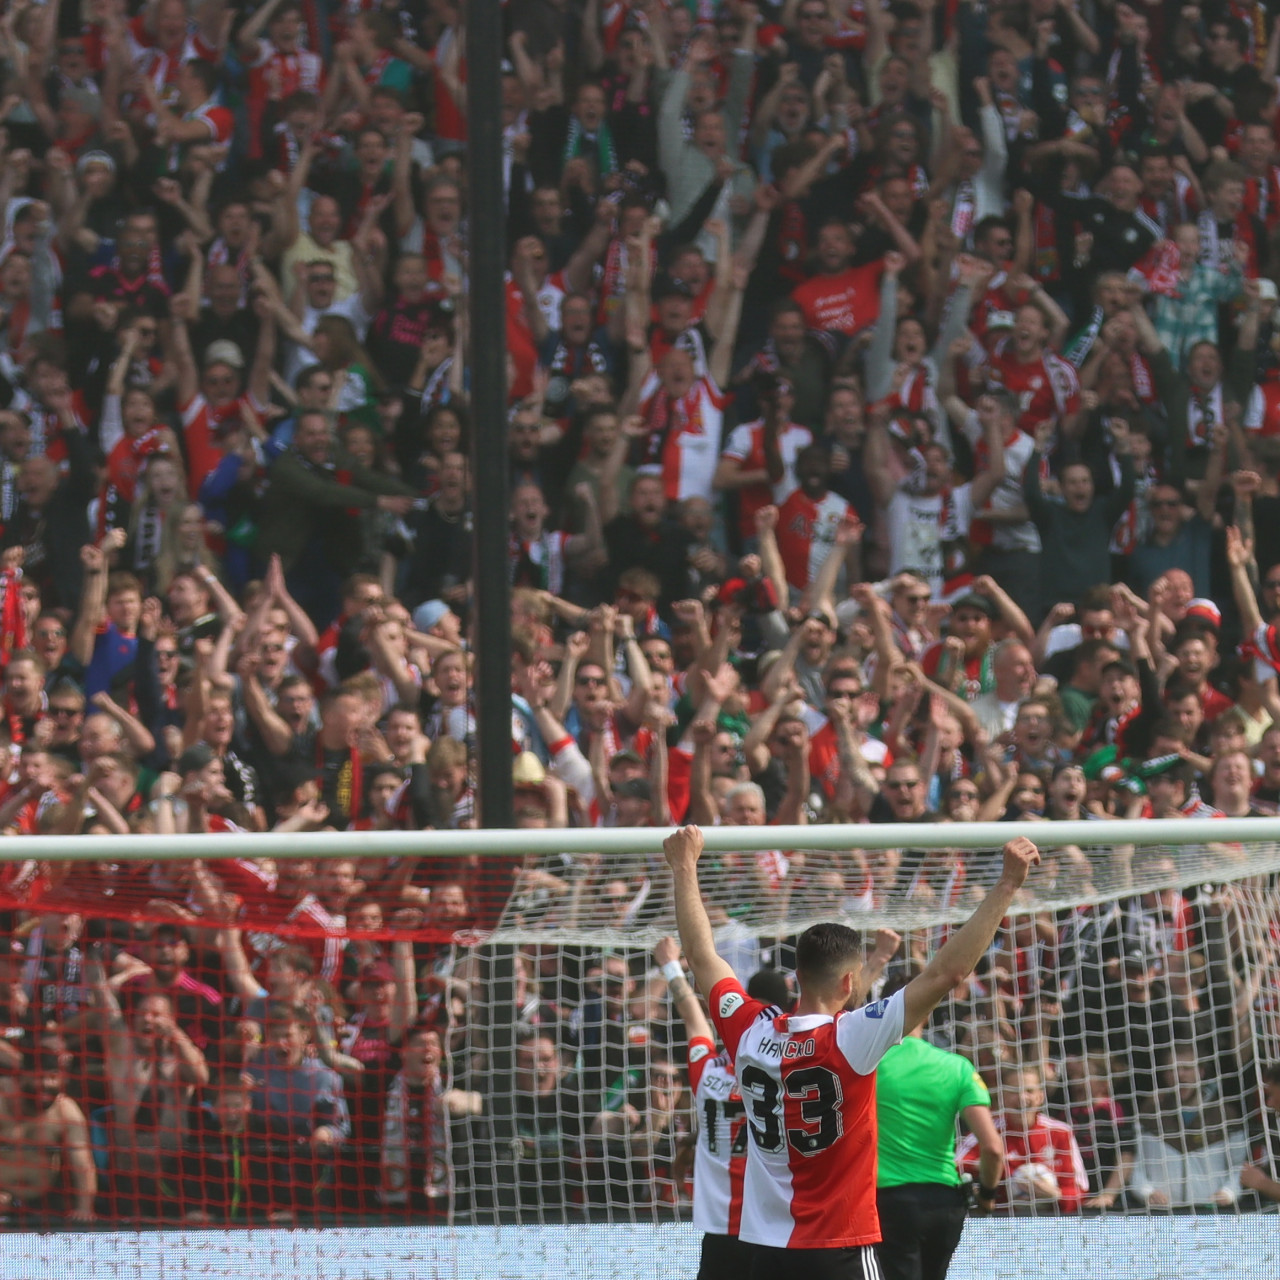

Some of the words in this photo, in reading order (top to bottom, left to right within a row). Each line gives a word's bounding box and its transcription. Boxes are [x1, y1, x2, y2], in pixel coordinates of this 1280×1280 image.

[757, 1037, 815, 1058] HANCKO
[704, 1099, 747, 1154] 17
[741, 1066, 843, 1157] 33
